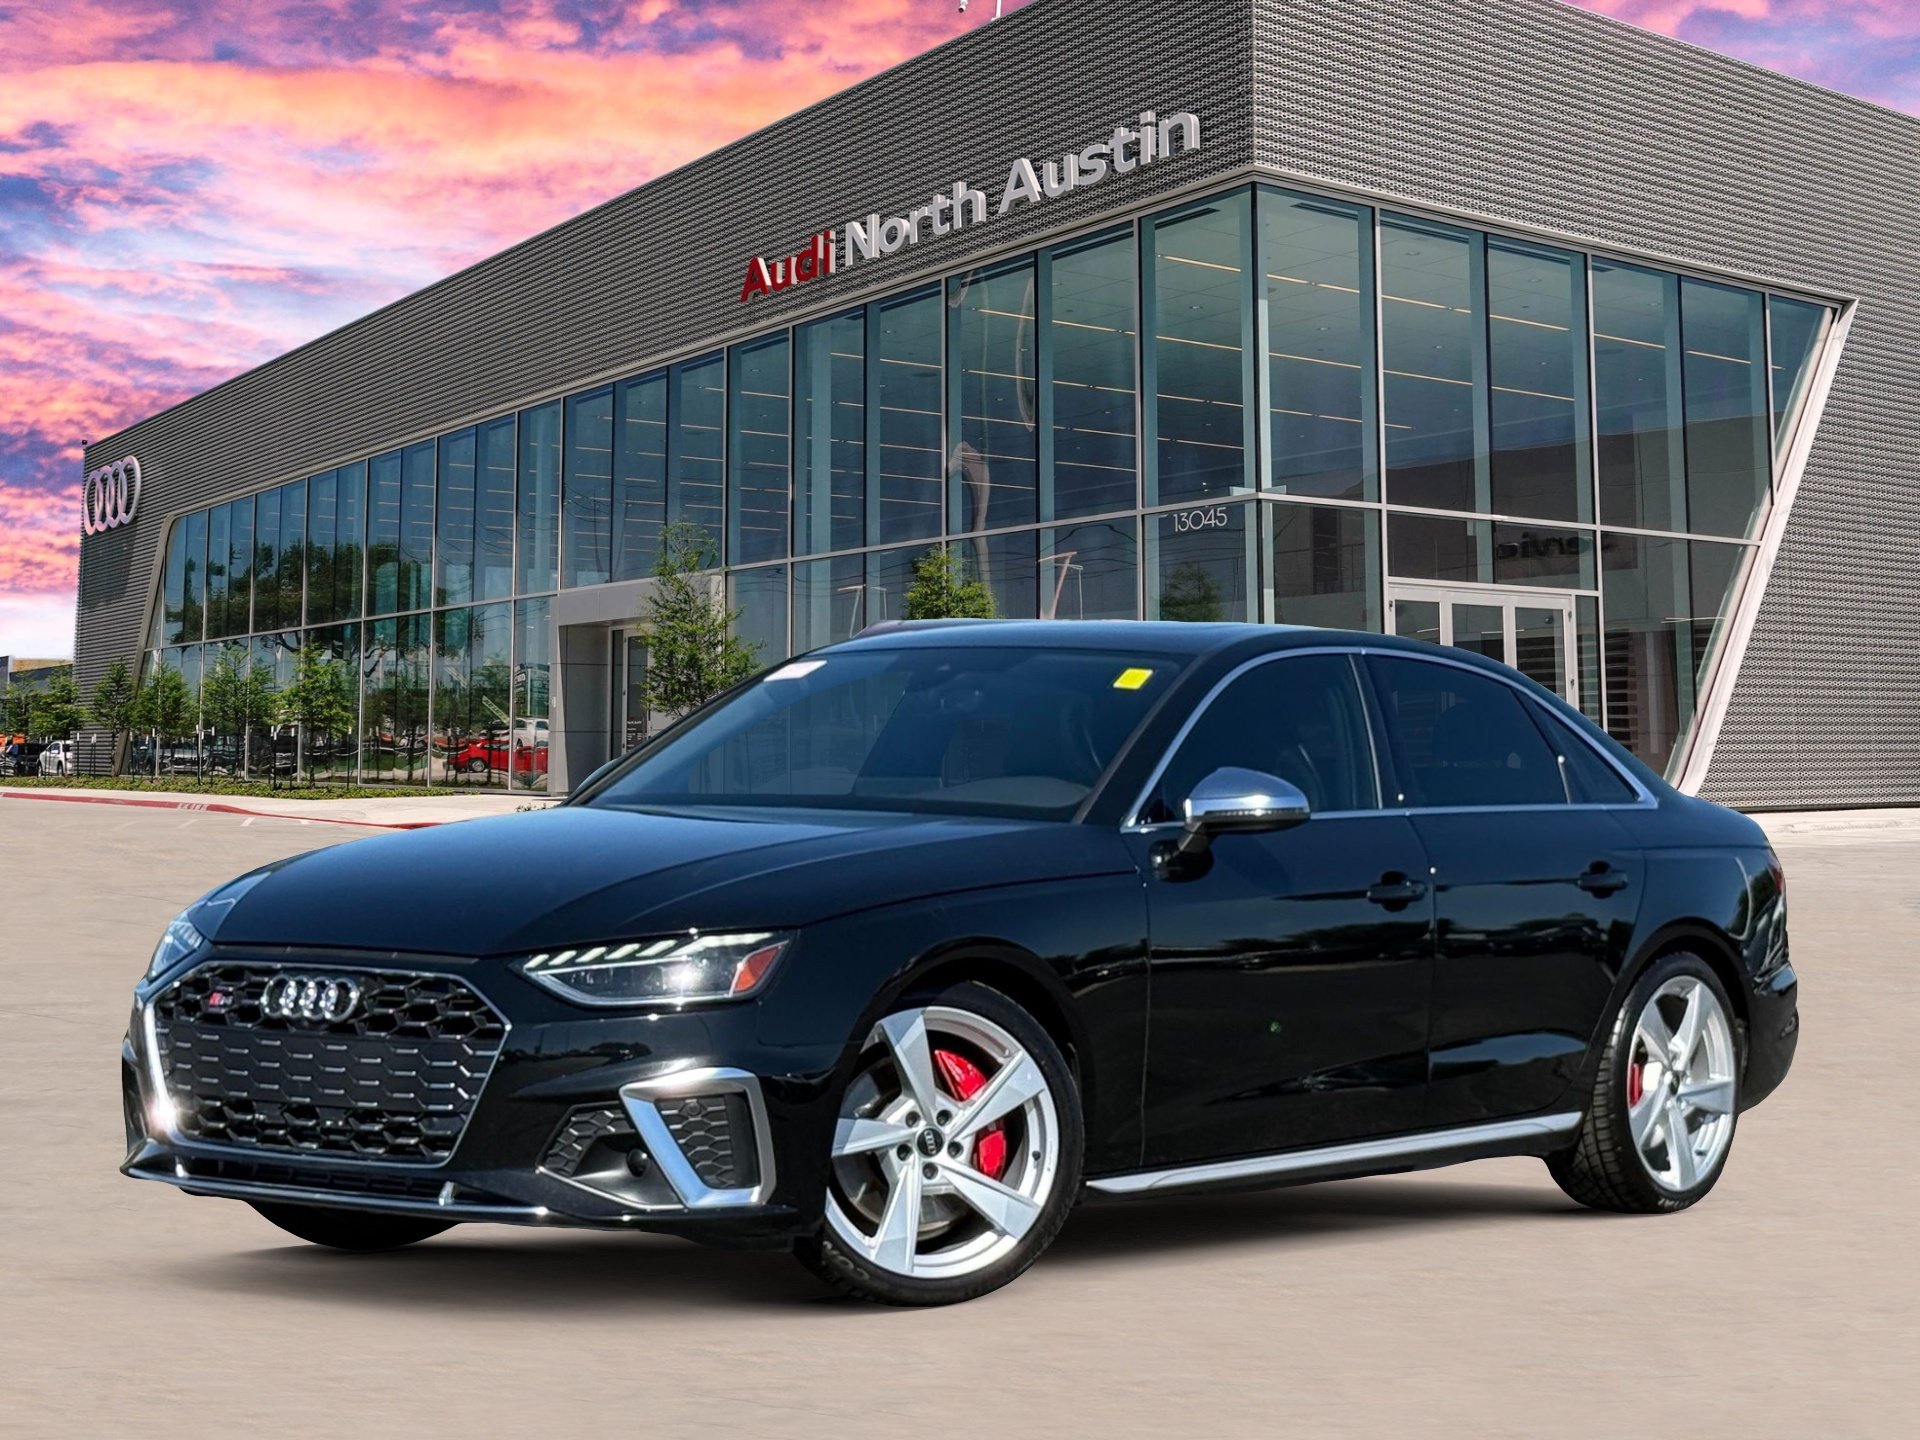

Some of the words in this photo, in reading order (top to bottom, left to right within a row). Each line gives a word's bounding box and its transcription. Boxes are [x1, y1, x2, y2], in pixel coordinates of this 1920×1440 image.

[740, 229, 836, 303] Audi
[845, 181, 987, 267] North
[998, 110, 1201, 214] Austin
[1173, 506, 1228, 532] 13045
